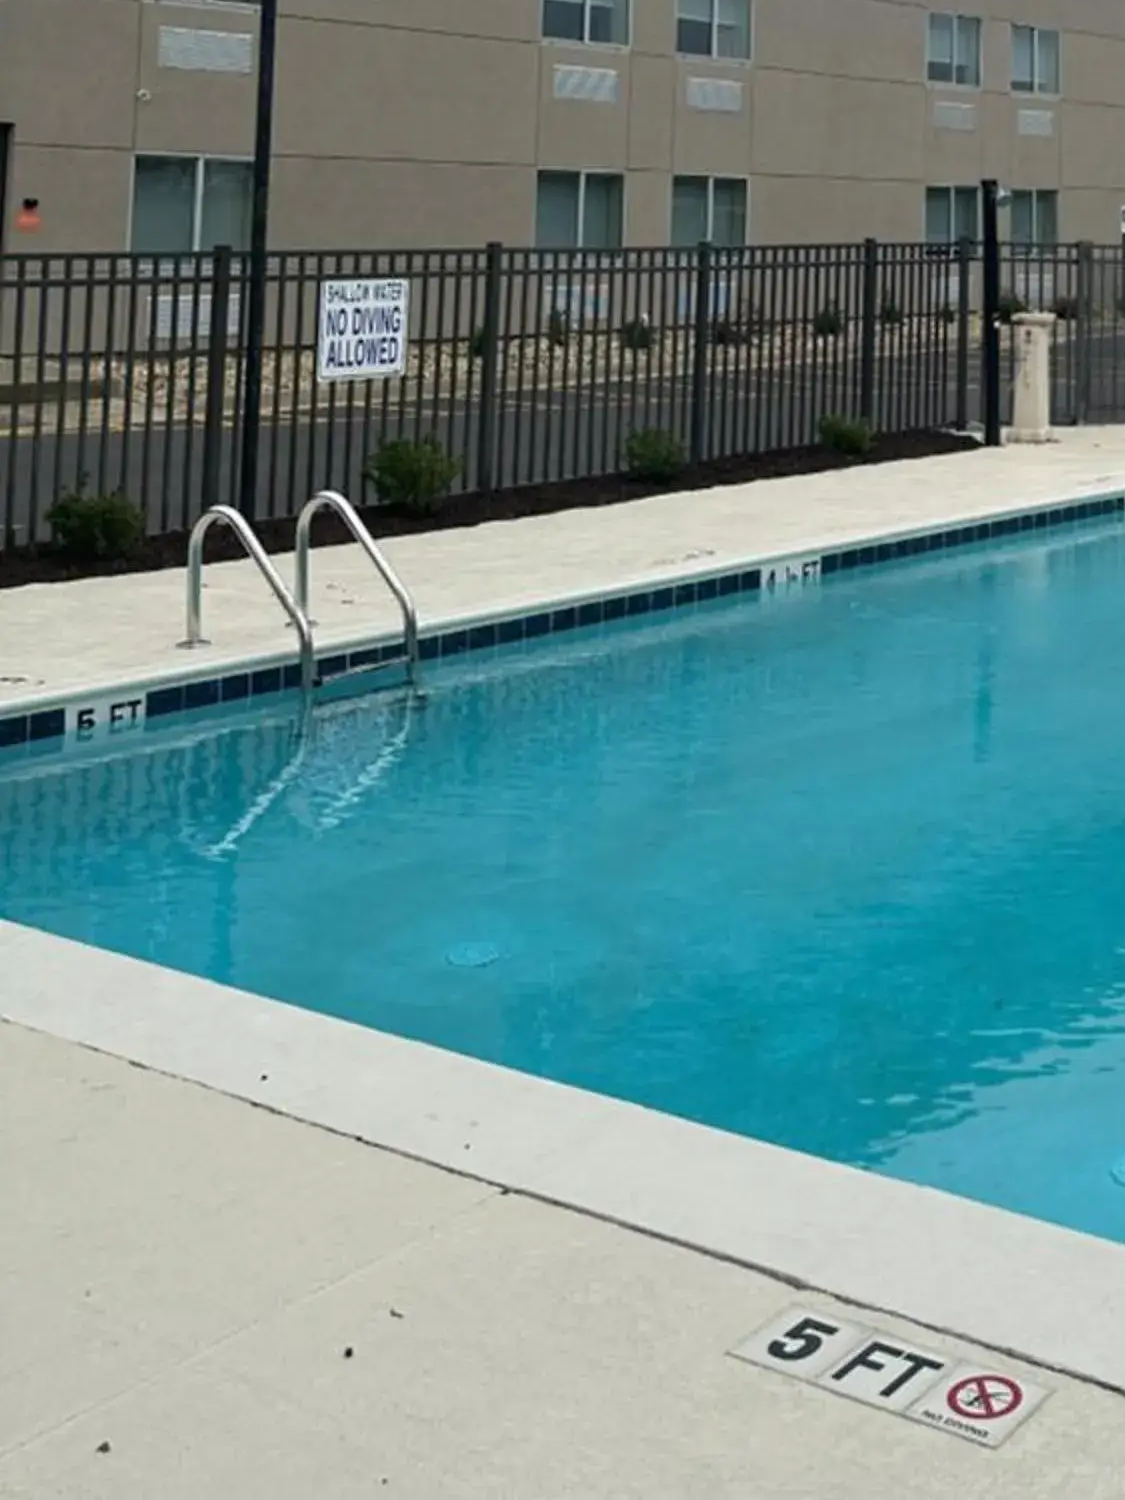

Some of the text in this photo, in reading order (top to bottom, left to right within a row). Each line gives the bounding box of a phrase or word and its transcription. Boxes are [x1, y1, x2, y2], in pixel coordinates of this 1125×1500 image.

[327, 282, 402, 303] SHALLOW WATER
[326, 305, 401, 336] NO DIVING
[325, 337, 399, 368] ALLOWED
[77, 699, 142, 731] 5 FT
[766, 1317, 945, 1398] 5 FT
